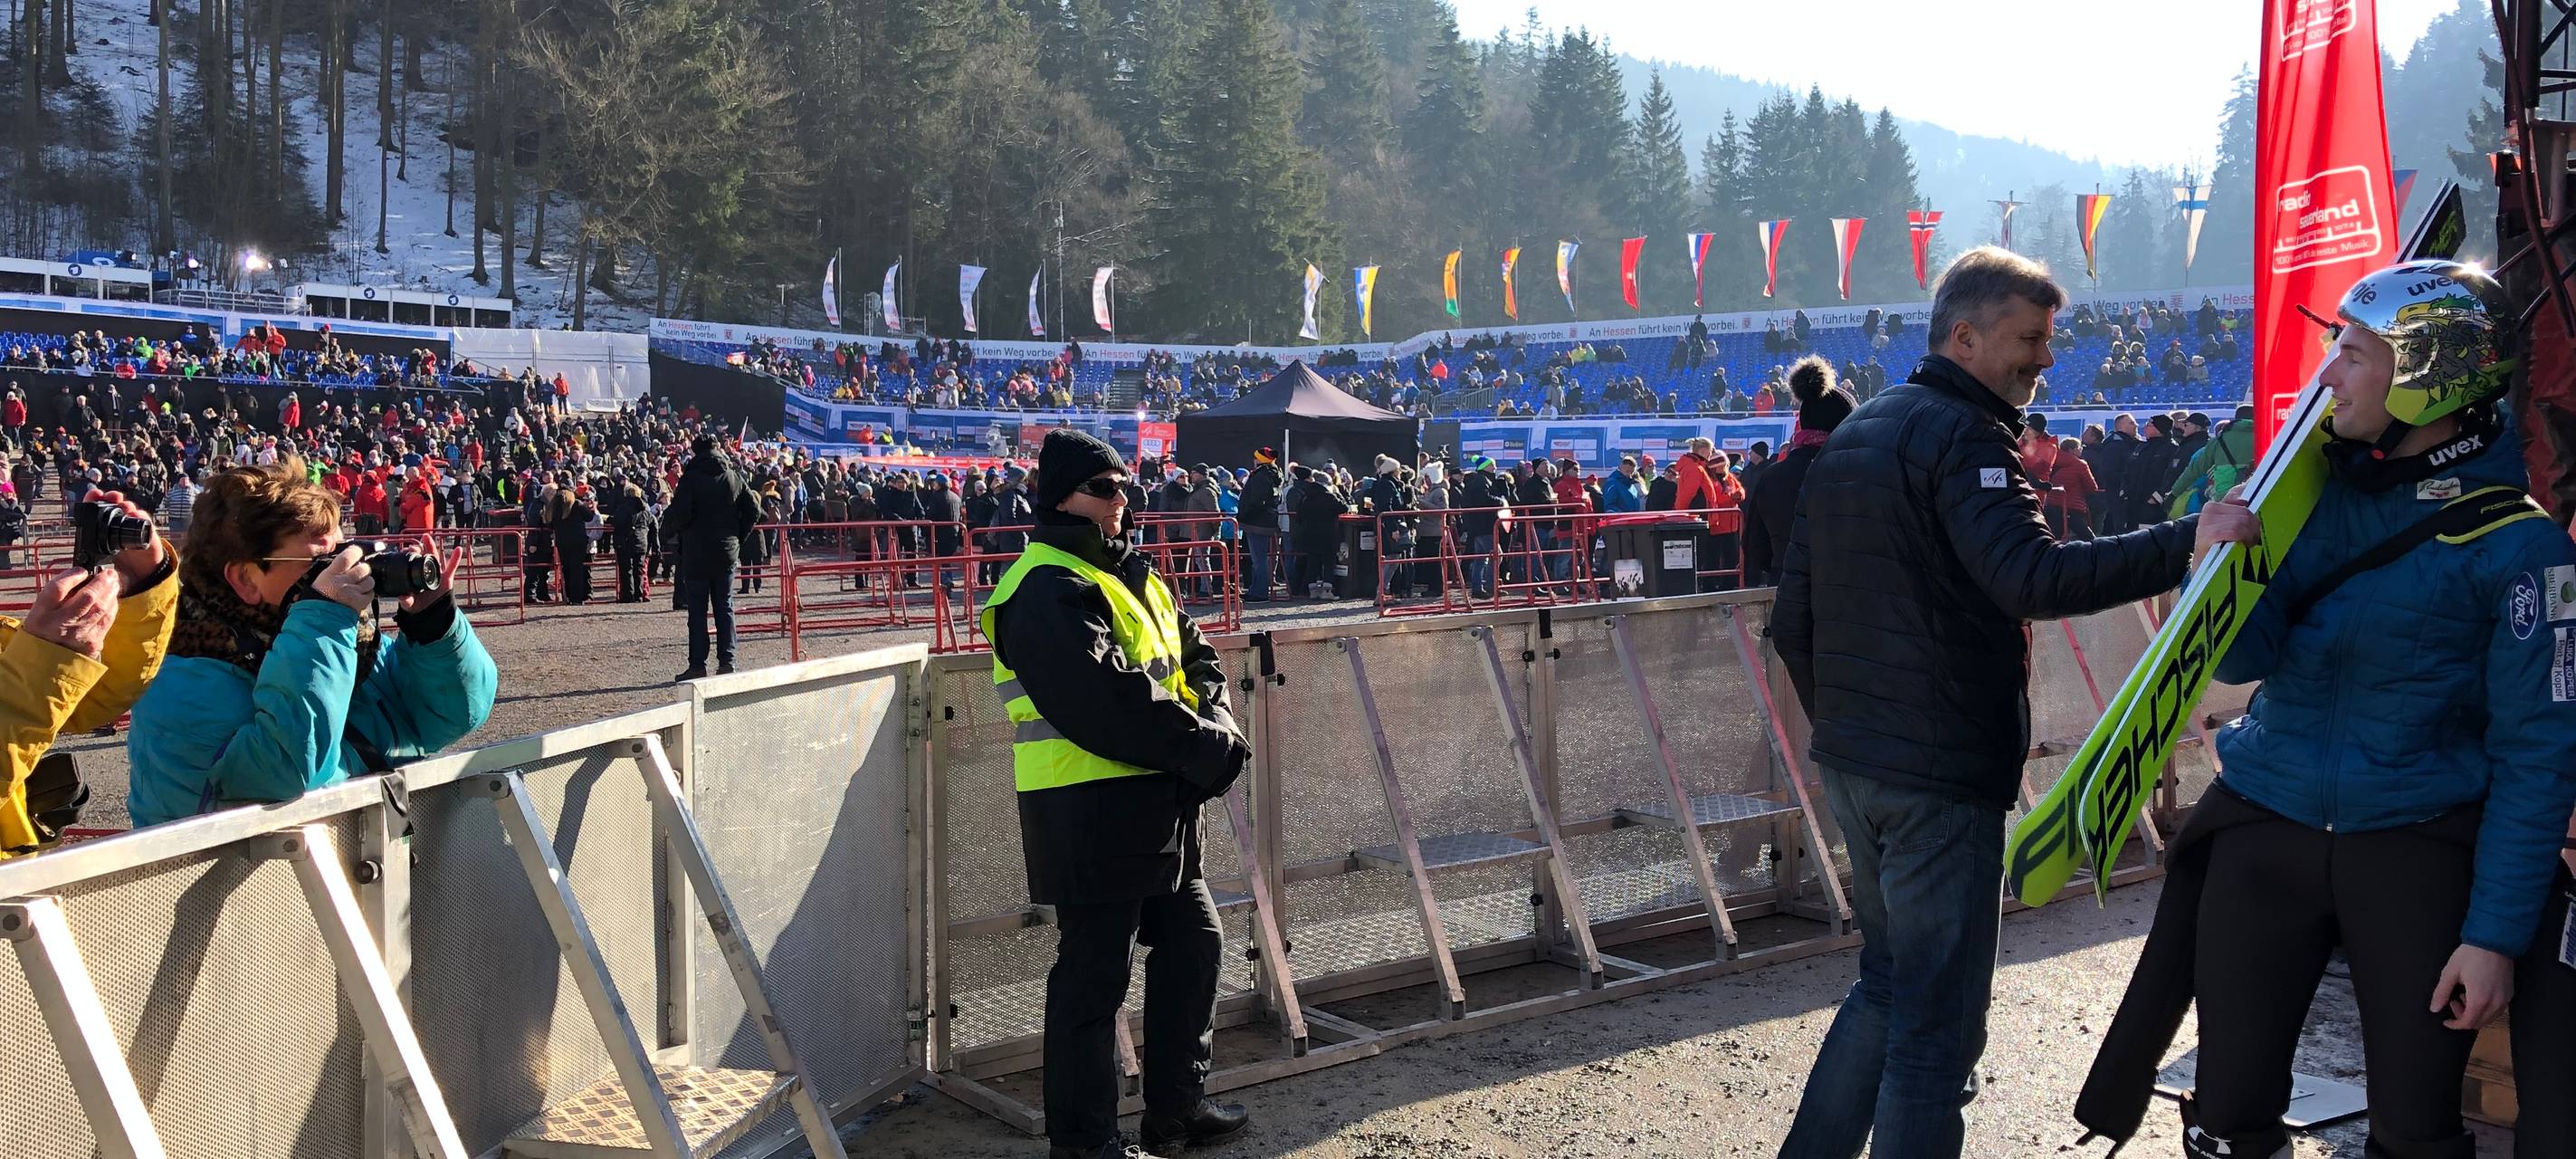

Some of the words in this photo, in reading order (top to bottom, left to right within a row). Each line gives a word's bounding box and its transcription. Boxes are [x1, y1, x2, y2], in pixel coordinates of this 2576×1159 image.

[2223, 292, 2254, 305] Hess
[1822, 312, 1846, 324] führt
[1902, 309, 1931, 321] vorbe
[657, 320, 667, 328] An
[668, 321, 693, 330] Hessen
[694, 322, 711, 331] führt
[1589, 327, 1601, 337] An
[1603, 325, 1636, 336] Hessen
[1638, 324, 1660, 334] führt
[1663, 322, 1681, 332] kein
[665, 328, 680, 336] kein
[681, 329, 696, 339] Weg
[983, 347, 1001, 356] kein
[1004, 348, 1024, 358] Weg
[1084, 350, 1097, 358] An
[1100, 349, 1134, 359] Hessen
[2428, 435, 2484, 466] uvex
[2546, 568, 2557, 620] SBERBANK
[2514, 582, 2536, 628] Ford
[2556, 639, 2565, 659] Port
[2565, 638, 2575, 662] LUKA
[2554, 660, 2563, 668] of
[2552, 670, 2563, 698] Koper
[2565, 666, 2576, 697] KOPER
[2086, 559, 2237, 880] FISCHER
